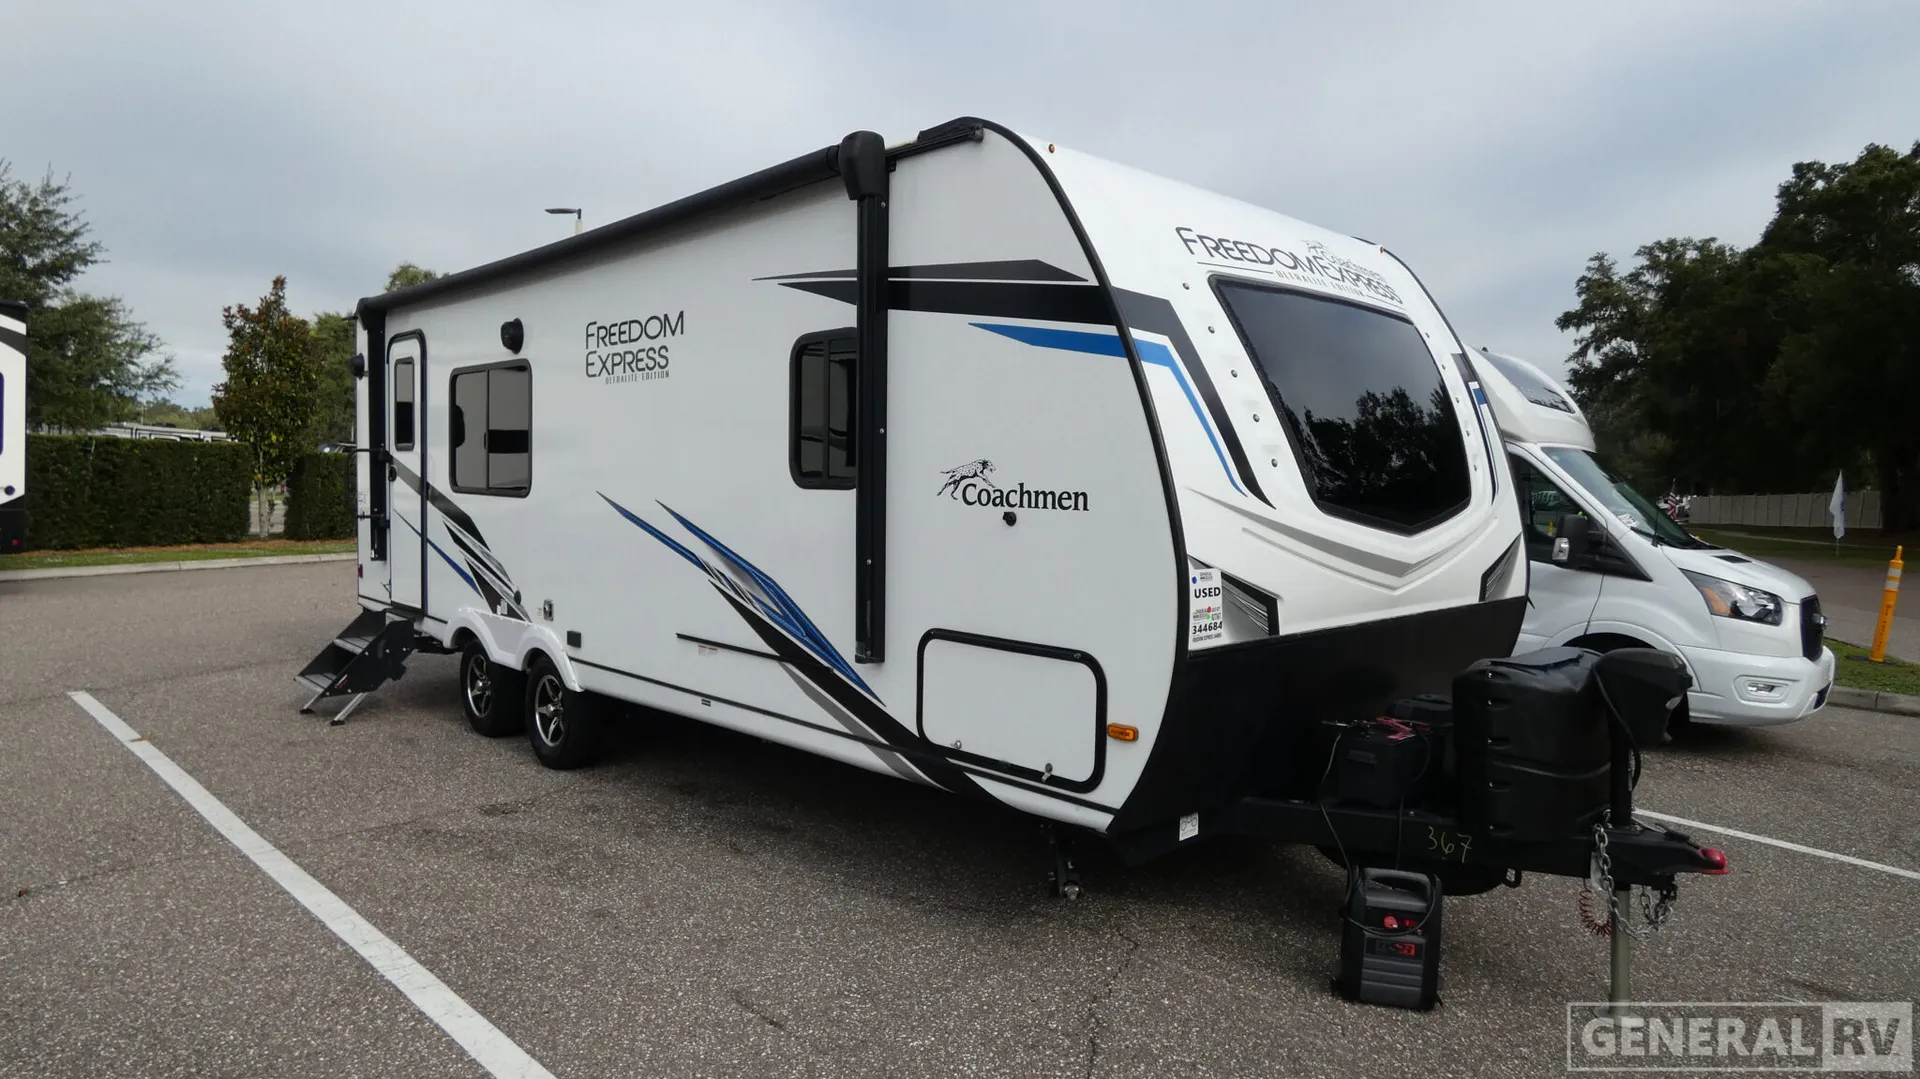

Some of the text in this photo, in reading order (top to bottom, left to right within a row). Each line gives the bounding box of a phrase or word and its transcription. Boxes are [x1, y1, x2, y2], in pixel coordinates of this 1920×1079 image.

[586, 310, 684, 350] FREEDOM
[586, 345, 669, 378] EXPRESS
[962, 482, 1089, 512] Coachmen
[1194, 587, 1221, 598] USED
[1192, 621, 1222, 635] 344684
[1428, 825, 1472, 864] 367
